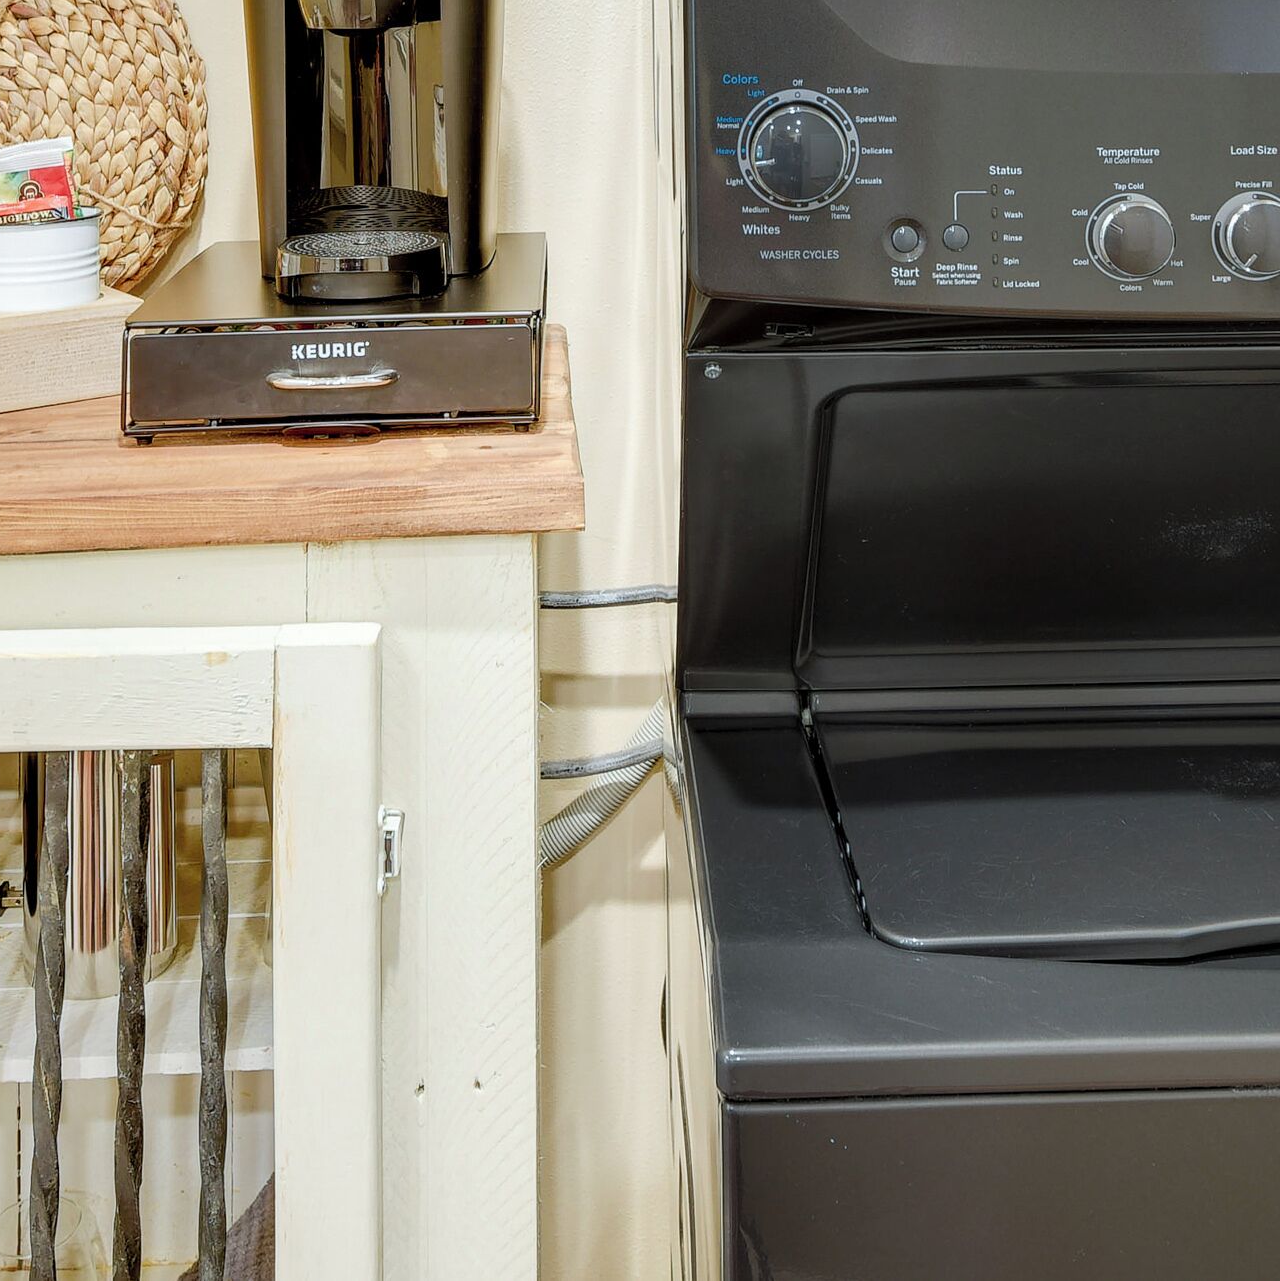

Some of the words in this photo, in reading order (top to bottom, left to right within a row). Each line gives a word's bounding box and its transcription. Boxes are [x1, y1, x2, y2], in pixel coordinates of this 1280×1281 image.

[722, 73, 759, 86] Colors
[792, 79, 804, 87] Off
[747, 90, 765, 98] Light
[853, 87, 869, 95] Spin
[855, 116, 877, 124] Speed
[716, 148, 737, 156] Heavy
[1096, 147, 1160, 158] Temperature
[1230, 146, 1255, 156] Load
[1257, 145, 1278, 155] Size
[1104, 157, 1113, 165] All
[1114, 157, 1130, 165] Cold
[1131, 157, 1153, 165] Rinses
[989, 165, 1023, 175] Status
[726, 178, 744, 186] Light
[1114, 183, 1127, 191] Tap
[1004, 188, 1015, 196] On
[742, 206, 770, 214] Medium
[830, 205, 850, 213] Bulky
[1072, 209, 1089, 217] Cold
[788, 214, 811, 223] Heavy
[1003, 211, 1024, 219] Wash
[1190, 214, 1211, 222] Super
[742, 224, 781, 235] Whites
[1003, 234, 1023, 242] Rinse
[760, 250, 801, 260] WASHER
[802, 250, 840, 260] CYCLES
[1003, 257, 1020, 266] Spin
[1073, 258, 1090, 266] Cool
[936, 263, 956, 272] Deep
[957, 263, 978, 271] Rinse
[891, 267, 921, 278] Start
[1212, 275, 1232, 284] Large
[1003, 280, 1014, 288] Lid
[1015, 280, 1040, 288] Locked
[1120, 284, 1142, 292] Colors
[291, 342, 368, 360] KEURIG
